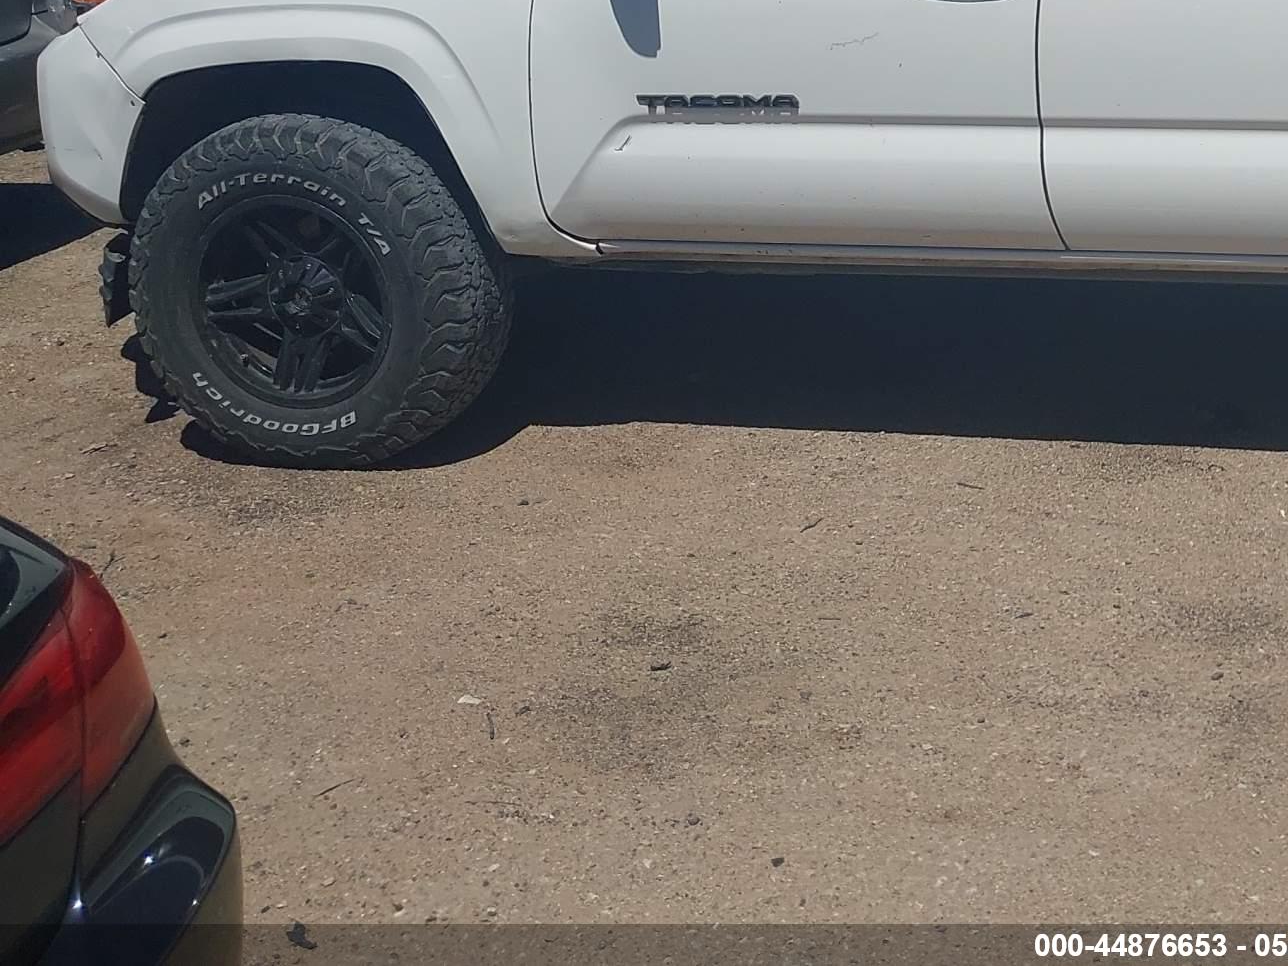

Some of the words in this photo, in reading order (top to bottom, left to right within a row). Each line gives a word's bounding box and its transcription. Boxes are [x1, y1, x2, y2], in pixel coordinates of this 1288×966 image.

[636, 94, 800, 124] TACOMA
[198, 172, 346, 210] All-Terrain
[357, 212, 391, 256] T/A
[192, 372, 357, 436] BFGoodrich
